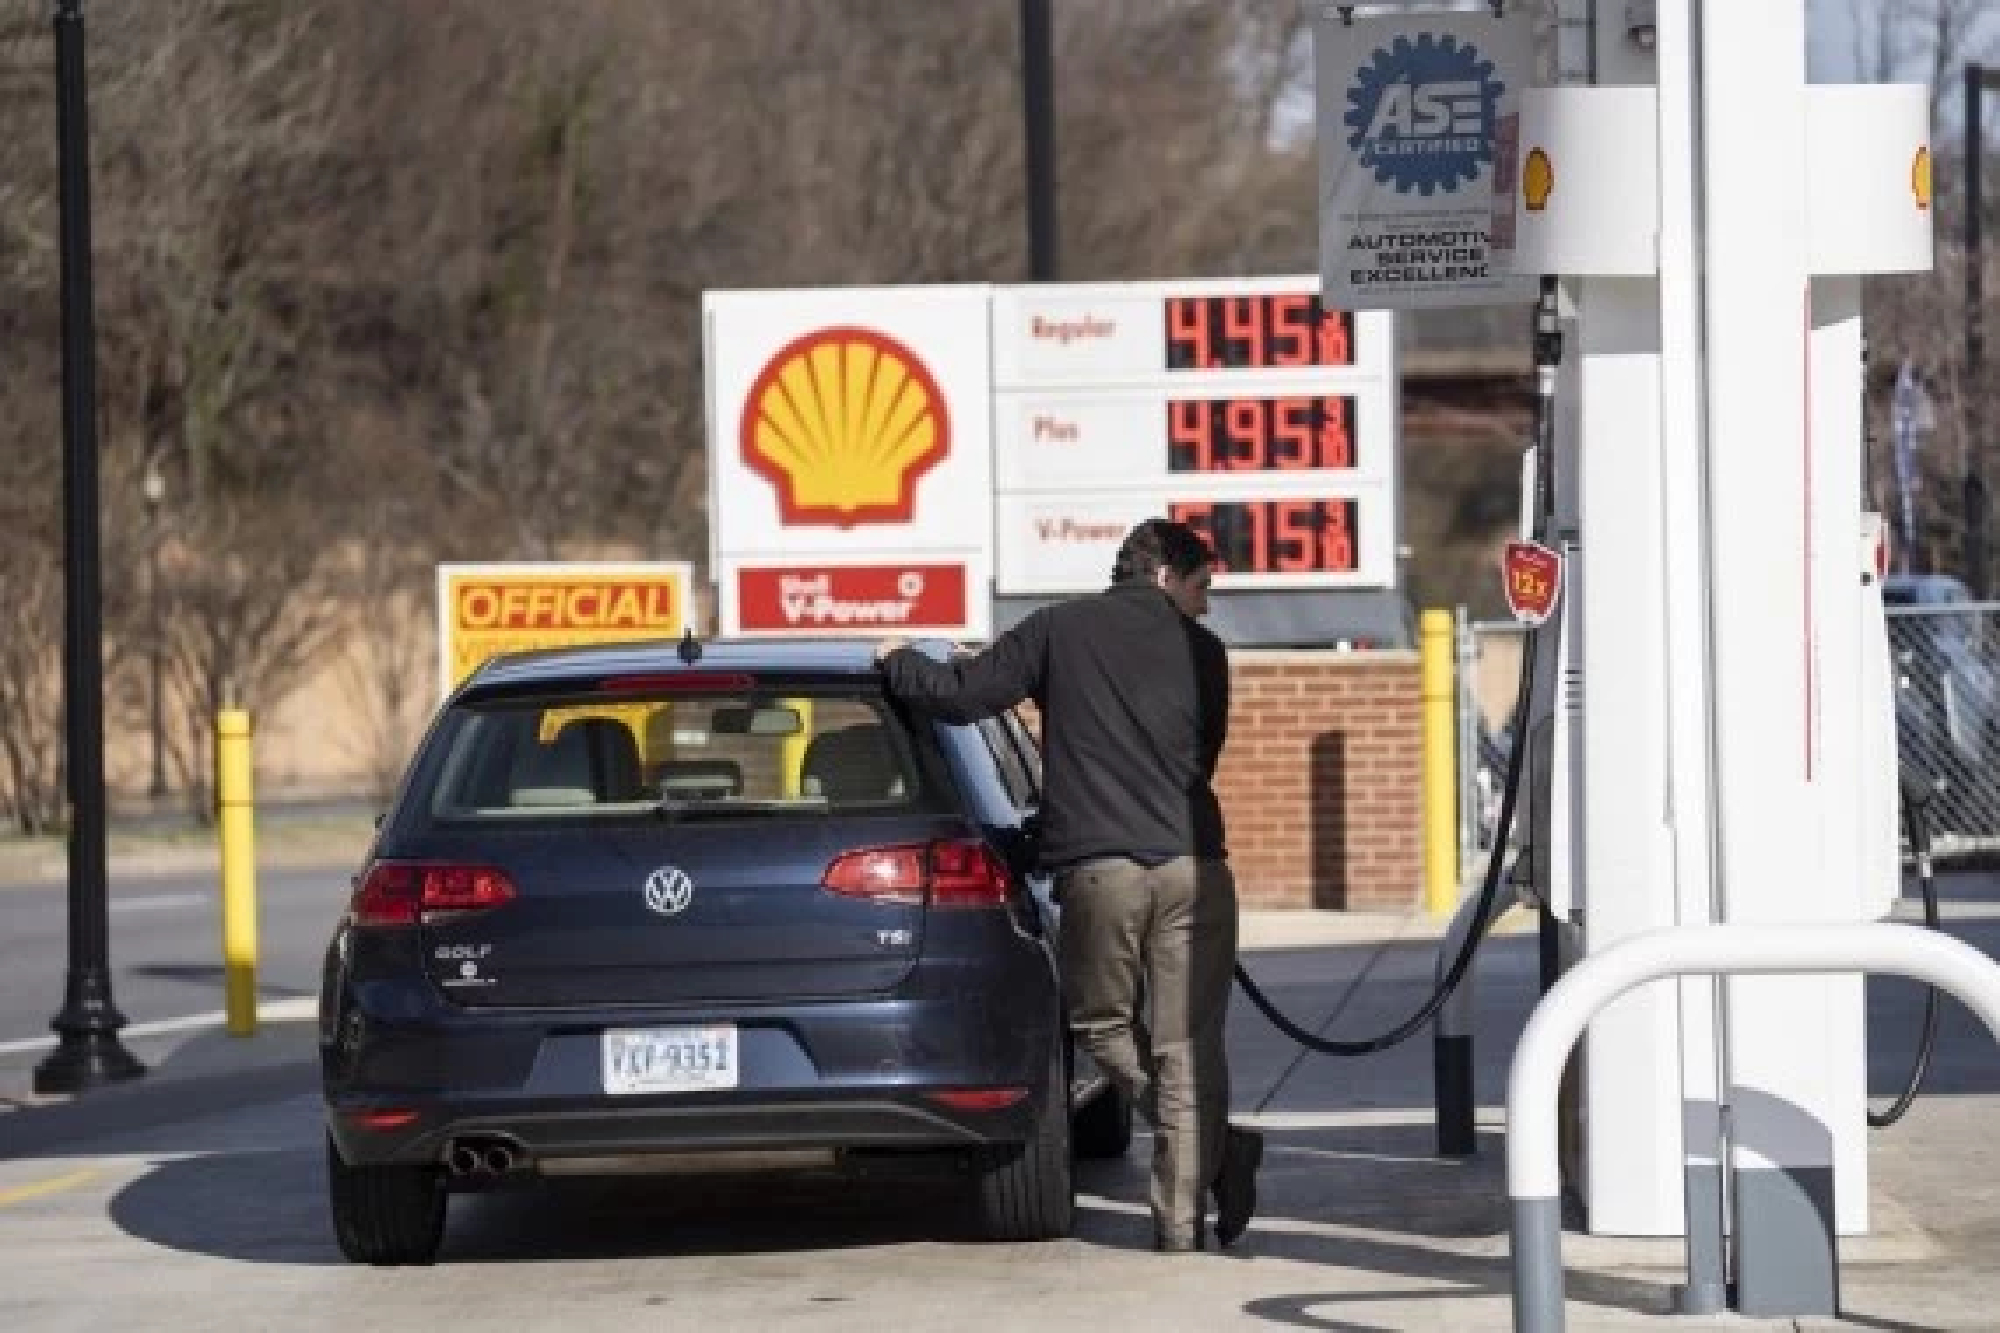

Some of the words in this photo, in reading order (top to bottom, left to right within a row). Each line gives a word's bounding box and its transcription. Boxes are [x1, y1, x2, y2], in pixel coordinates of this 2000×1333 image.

[1364, 81, 1482, 138] ASE
[1347, 231, 1492, 249] AUTOMOTIV
[1377, 247, 1484, 266] SERVICE
[1350, 263, 1489, 284] EXCELLENC
[1031, 316, 1115, 343] Regular
[1033, 417, 1080, 442] Plus
[459, 586, 671, 627] OFFICIAL
[779, 592, 914, 622] V-Power
[434, 943, 493, 959] GOLF
